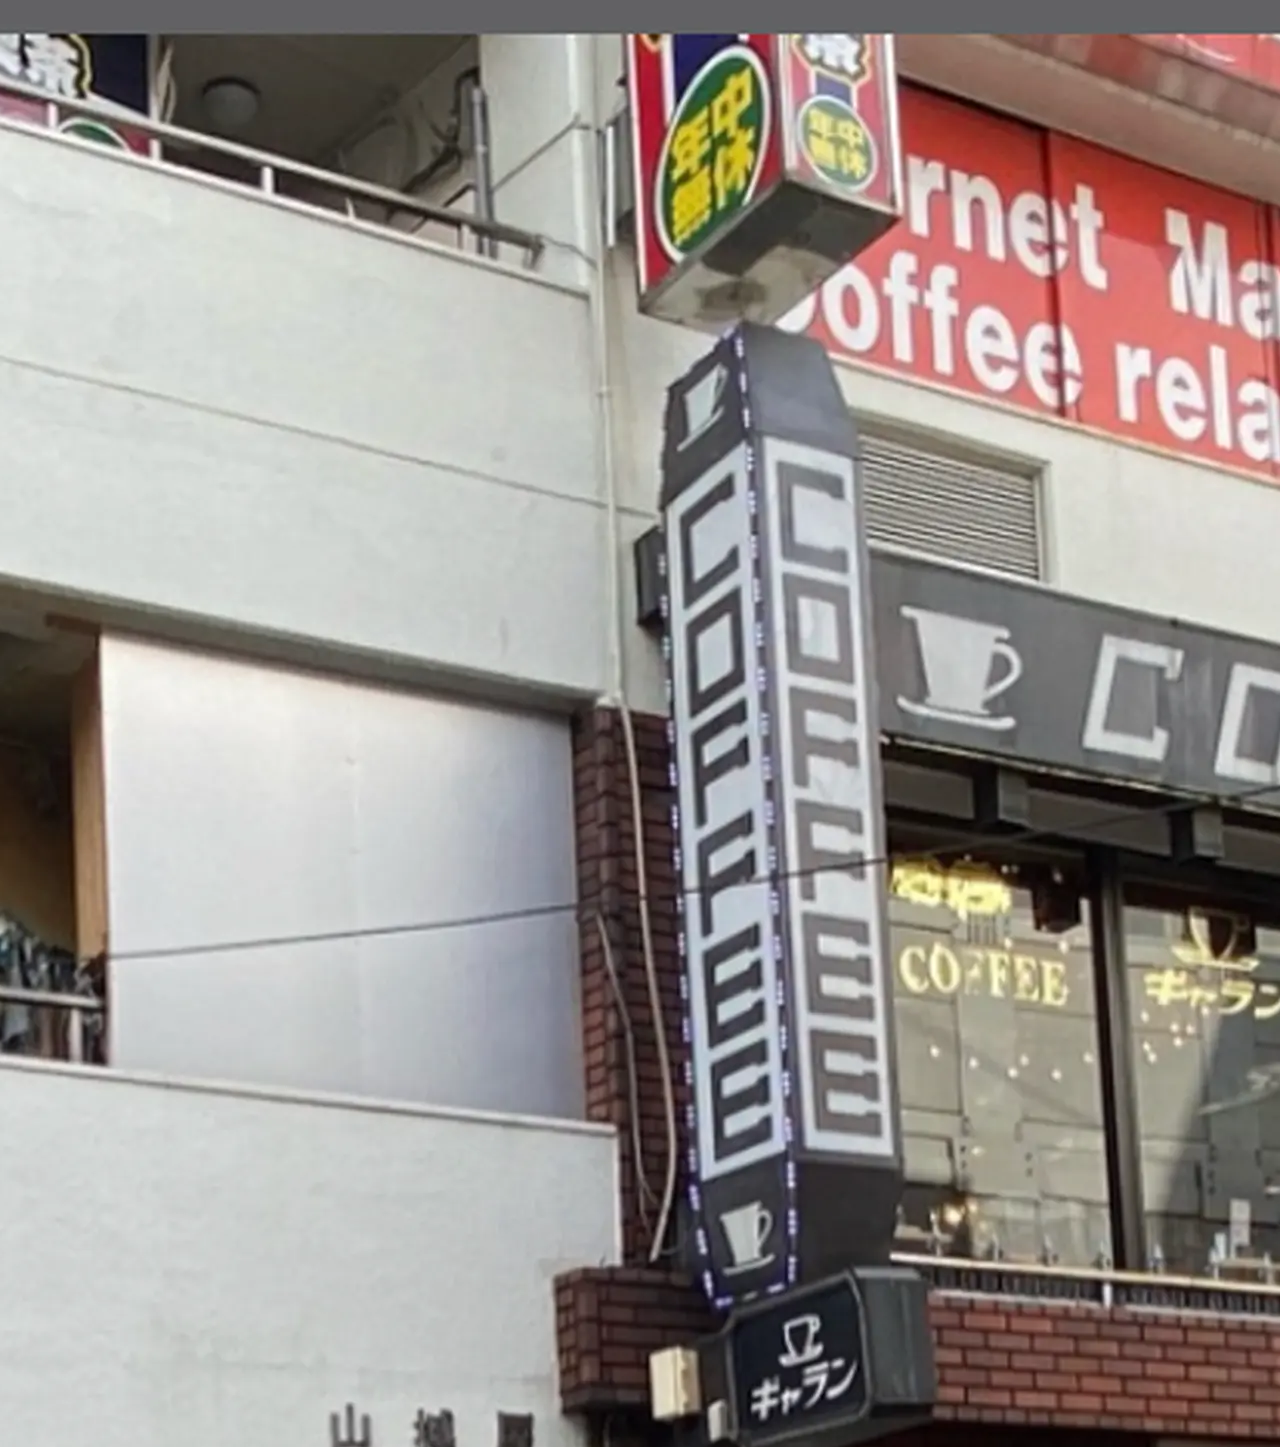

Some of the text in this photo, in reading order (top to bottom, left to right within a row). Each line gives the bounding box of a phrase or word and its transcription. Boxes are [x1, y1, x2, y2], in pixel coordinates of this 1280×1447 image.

[907, 150, 1110, 292] rnet
[678, 471, 774, 1163] COFFEE
[776, 460, 883, 1138] COFFEE
[750, 1353, 859, 1422] ギャラン
